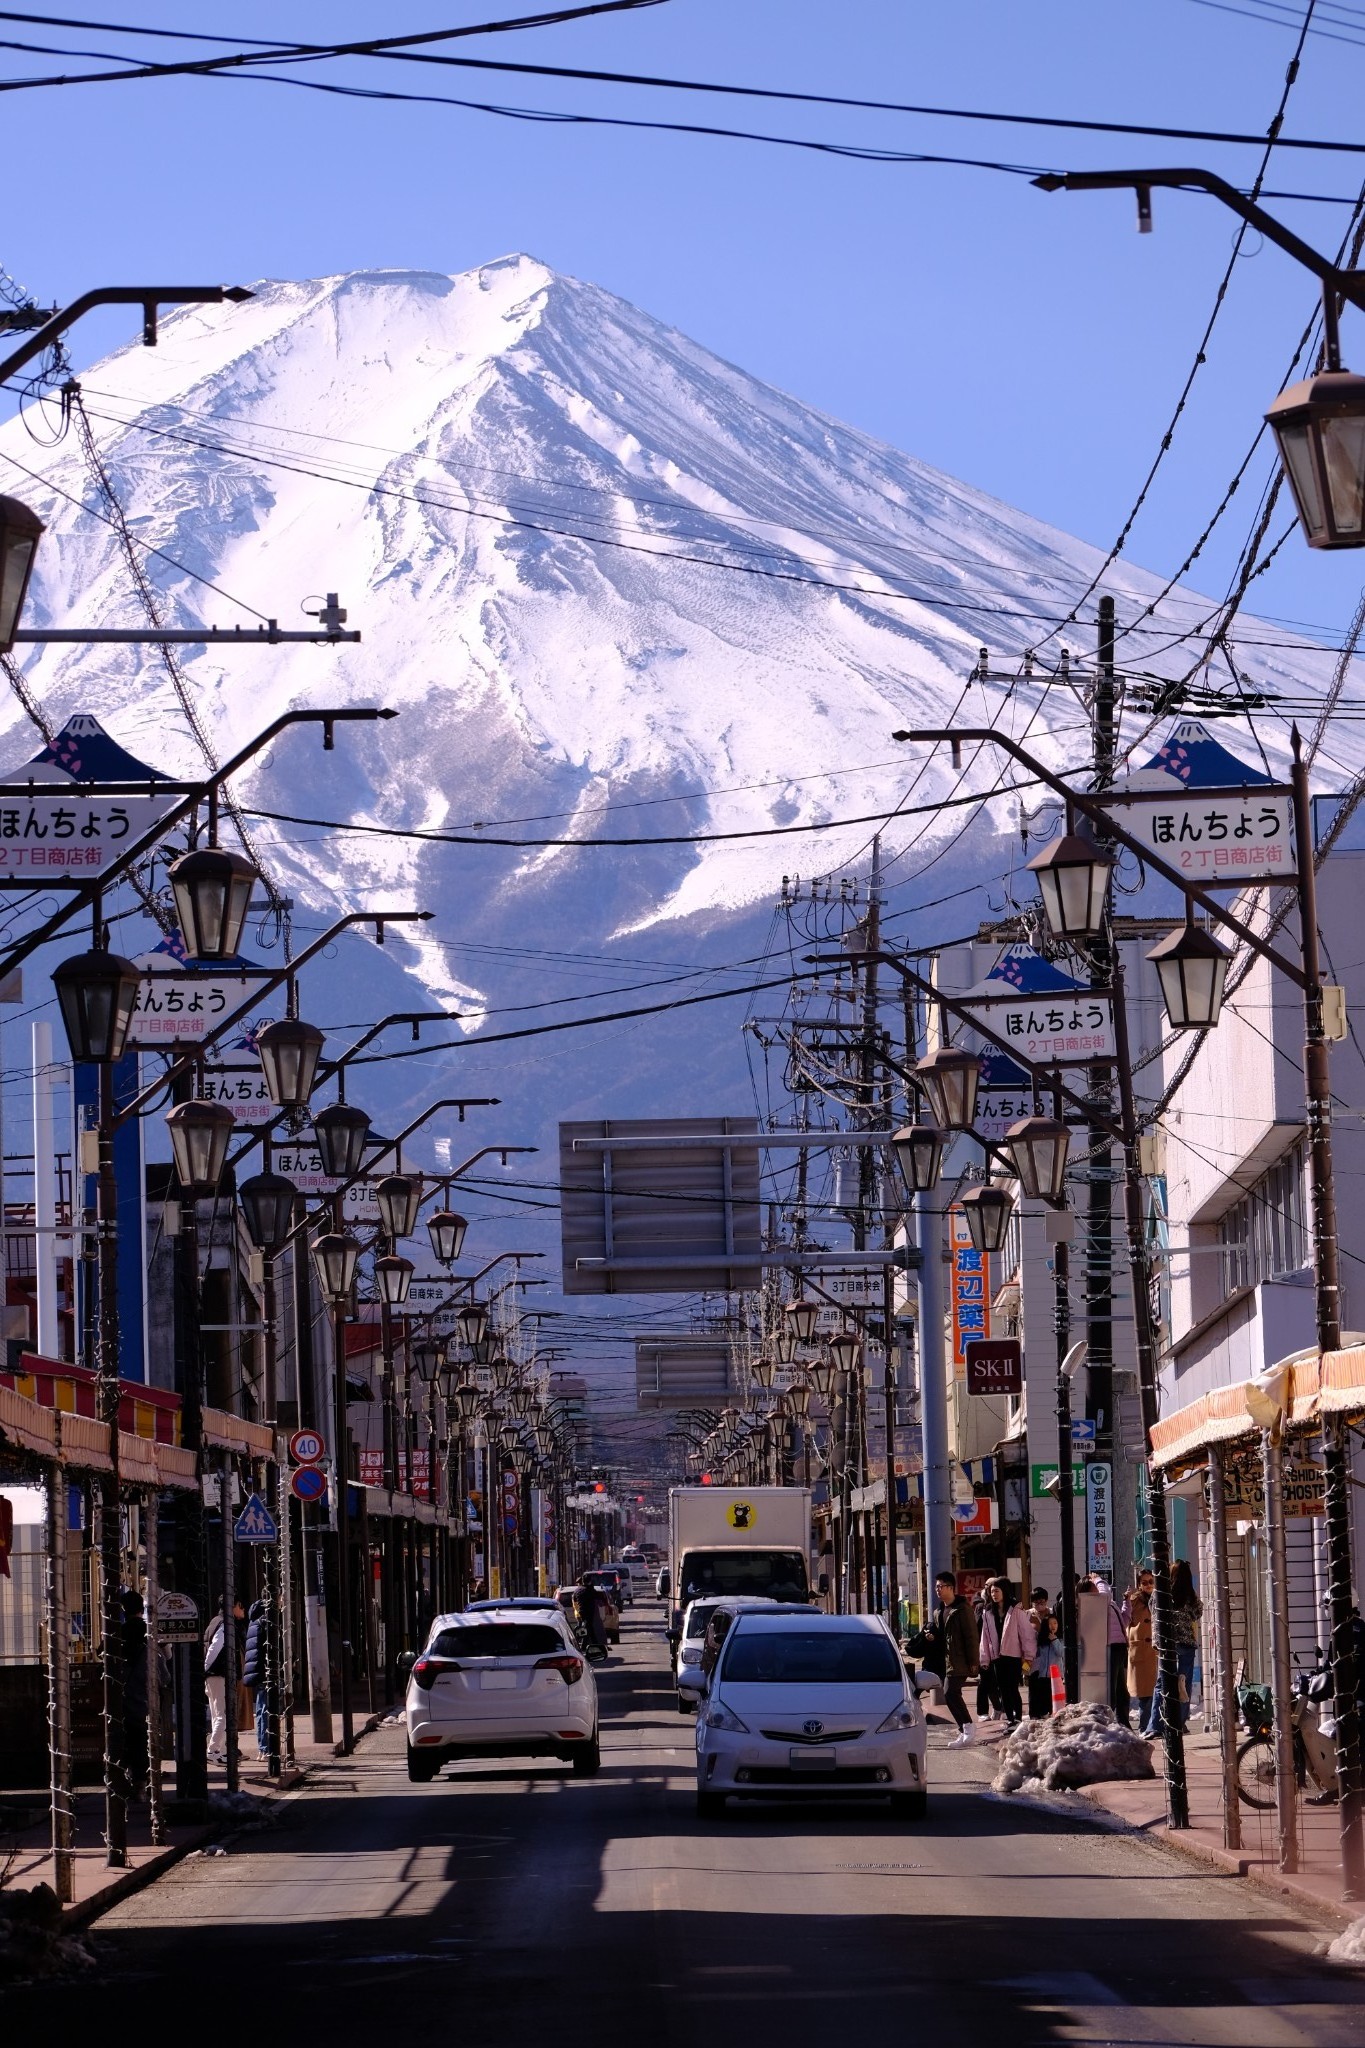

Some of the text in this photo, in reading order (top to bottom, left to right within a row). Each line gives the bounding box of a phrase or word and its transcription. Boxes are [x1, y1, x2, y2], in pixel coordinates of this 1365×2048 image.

[0, 808, 129, 839] ほんちょう
[1152, 808, 1280, 843] ほんちょう
[1181, 845, 1282, 868] 2丁目商店街
[129, 1018, 204, 1033] 丁目商店街
[1006, 1006, 1104, 1035] ほんちょう
[1028, 1035, 1105, 1054] 2丁目商店街
[832, 1280, 880, 1293] 3丁目商栄会
[299, 1440, 317, 1454] 40
[1093, 1488, 1107, 1542] 渡辺歯科
